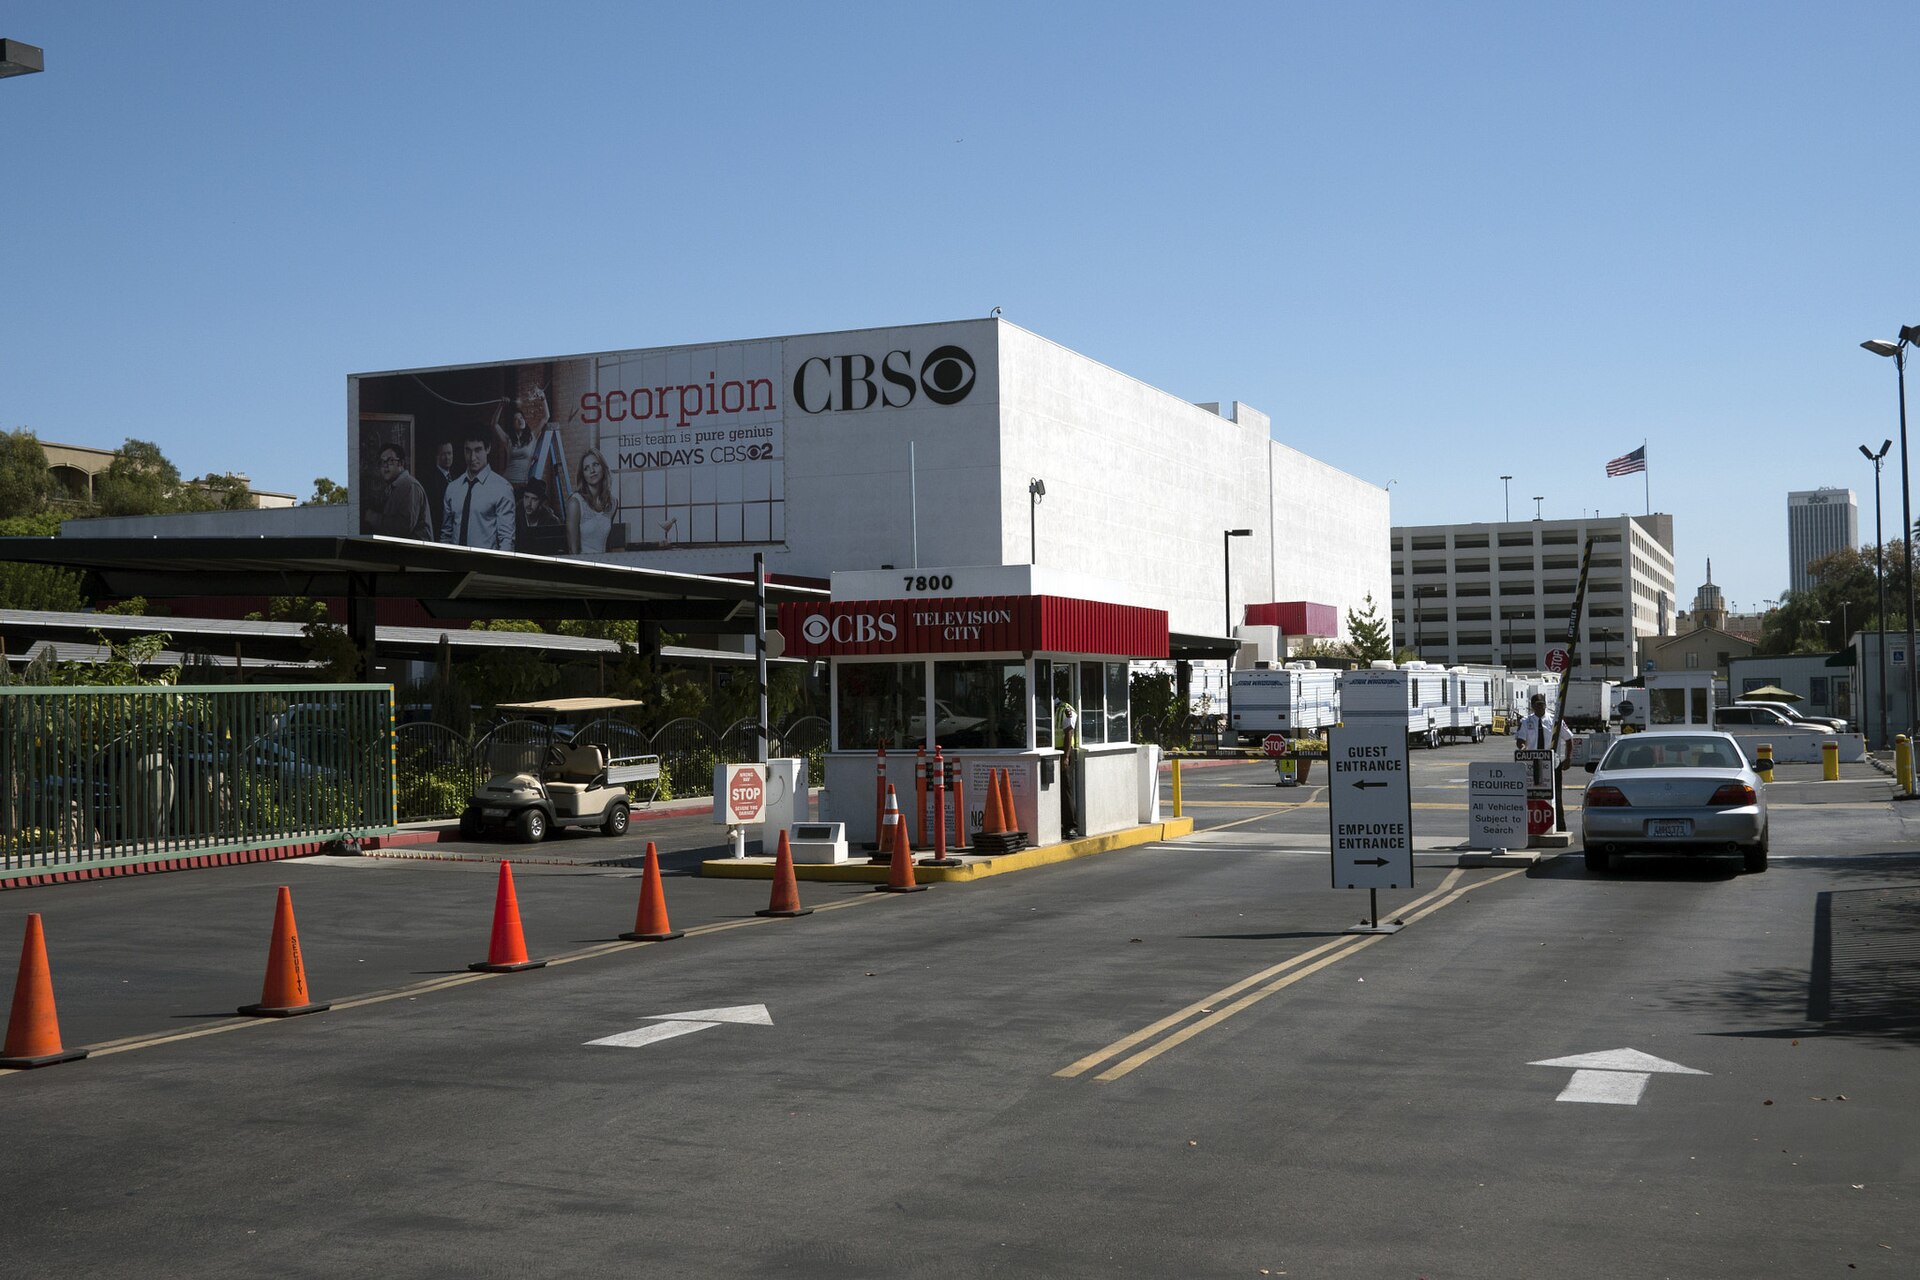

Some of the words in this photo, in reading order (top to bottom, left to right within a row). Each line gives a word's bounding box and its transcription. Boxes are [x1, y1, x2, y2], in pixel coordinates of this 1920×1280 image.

[793, 351, 916, 413] CBS
[580, 372, 776, 427] scorpion
[619, 435, 641, 447] this
[645, 434, 676, 446] team
[679, 432, 690, 444] is
[695, 431, 725, 445] pure
[729, 426, 773, 442] genius
[619, 449, 704, 469] MONDAYS
[1808, 493, 1829, 504] sbe
[904, 576, 953, 591] 7800
[913, 610, 1012, 626] TELEVISION
[832, 613, 897, 643] CBS
[944, 627, 982, 641] CITY
[1550, 650, 1564, 673] STOP
[1264, 740, 1285, 752] STOP
[1348, 746, 1388, 758] GUEST
[1516, 752, 1551, 760] CAUTION
[1336, 760, 1401, 772] ENTRANCE
[1489, 770, 1505, 778] I.D.
[1472, 781, 1524, 790] REQUIRED
[732, 788, 761, 800] STOP
[1473, 803, 1484, 811] All
[1488, 803, 1524, 812] Vehicles
[1475, 815, 1508, 824] Subject
[1512, 815, 1521, 823] to
[1528, 810, 1552, 824] TOP
[1338, 824, 1404, 836] EMPLOYEE
[1483, 826, 1514, 835] Search
[1338, 838, 1405, 849] ENTRANCE
[291, 936, 303, 995] SECURITY
